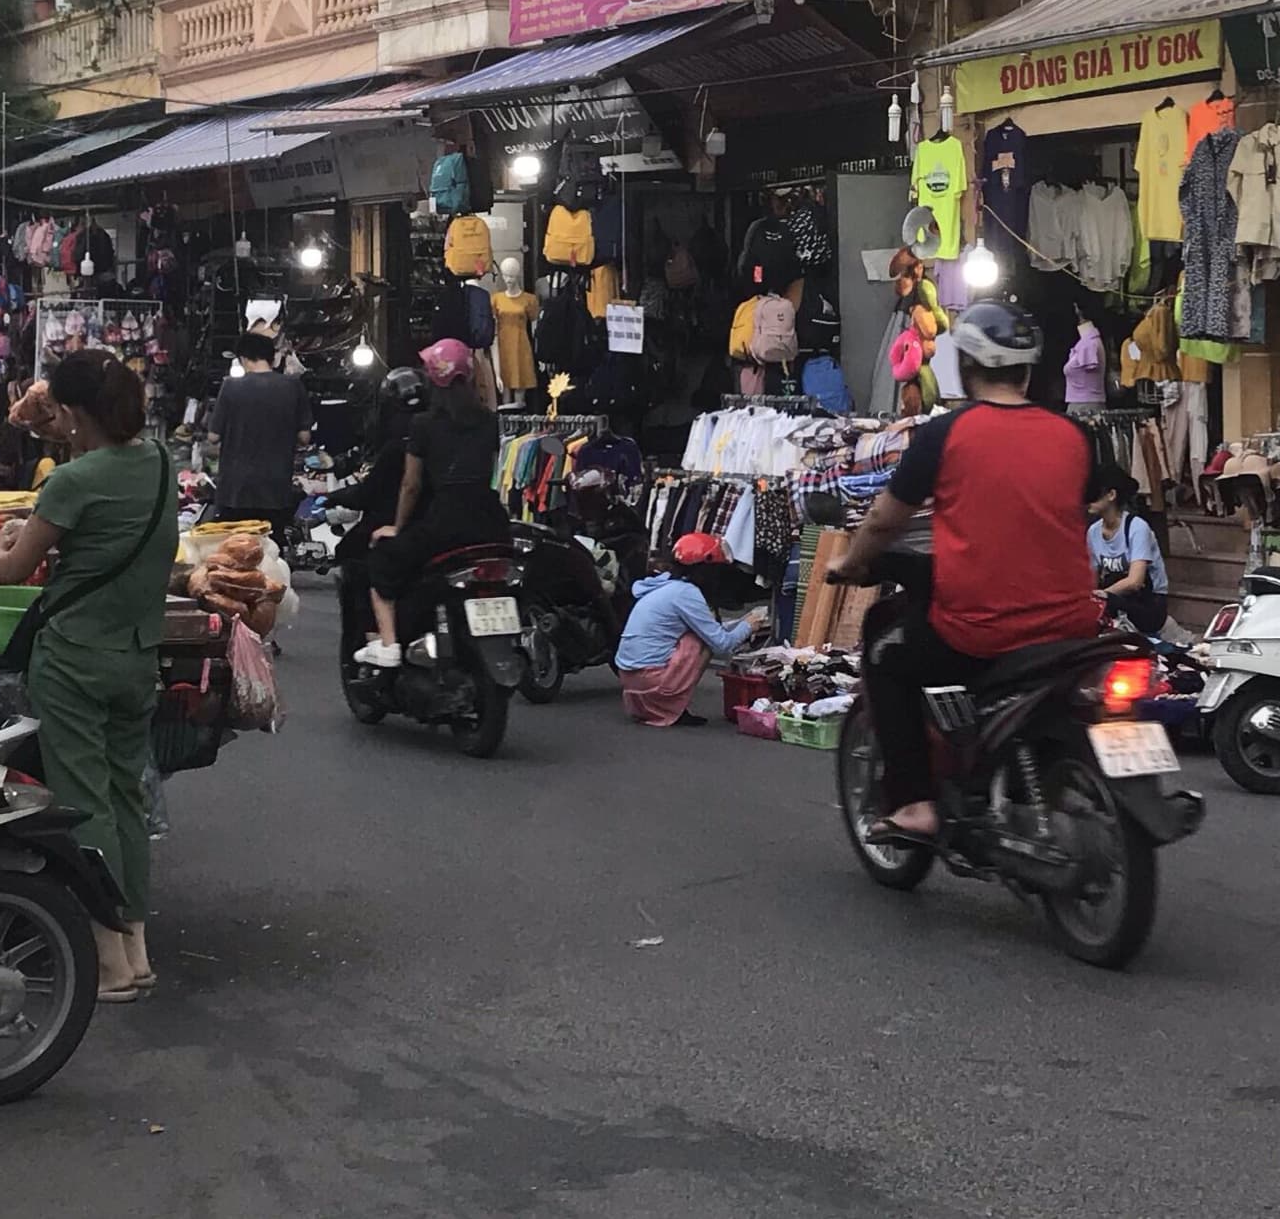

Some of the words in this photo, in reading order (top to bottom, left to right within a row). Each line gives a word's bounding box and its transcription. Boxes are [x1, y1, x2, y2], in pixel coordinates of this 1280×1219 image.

[1000, 51, 1067, 94] ĐỒNG
[1073, 41, 1113, 81] GIÁ
[1120, 34, 1152, 73] TỪ
[1157, 30, 1203, 66] 60K
